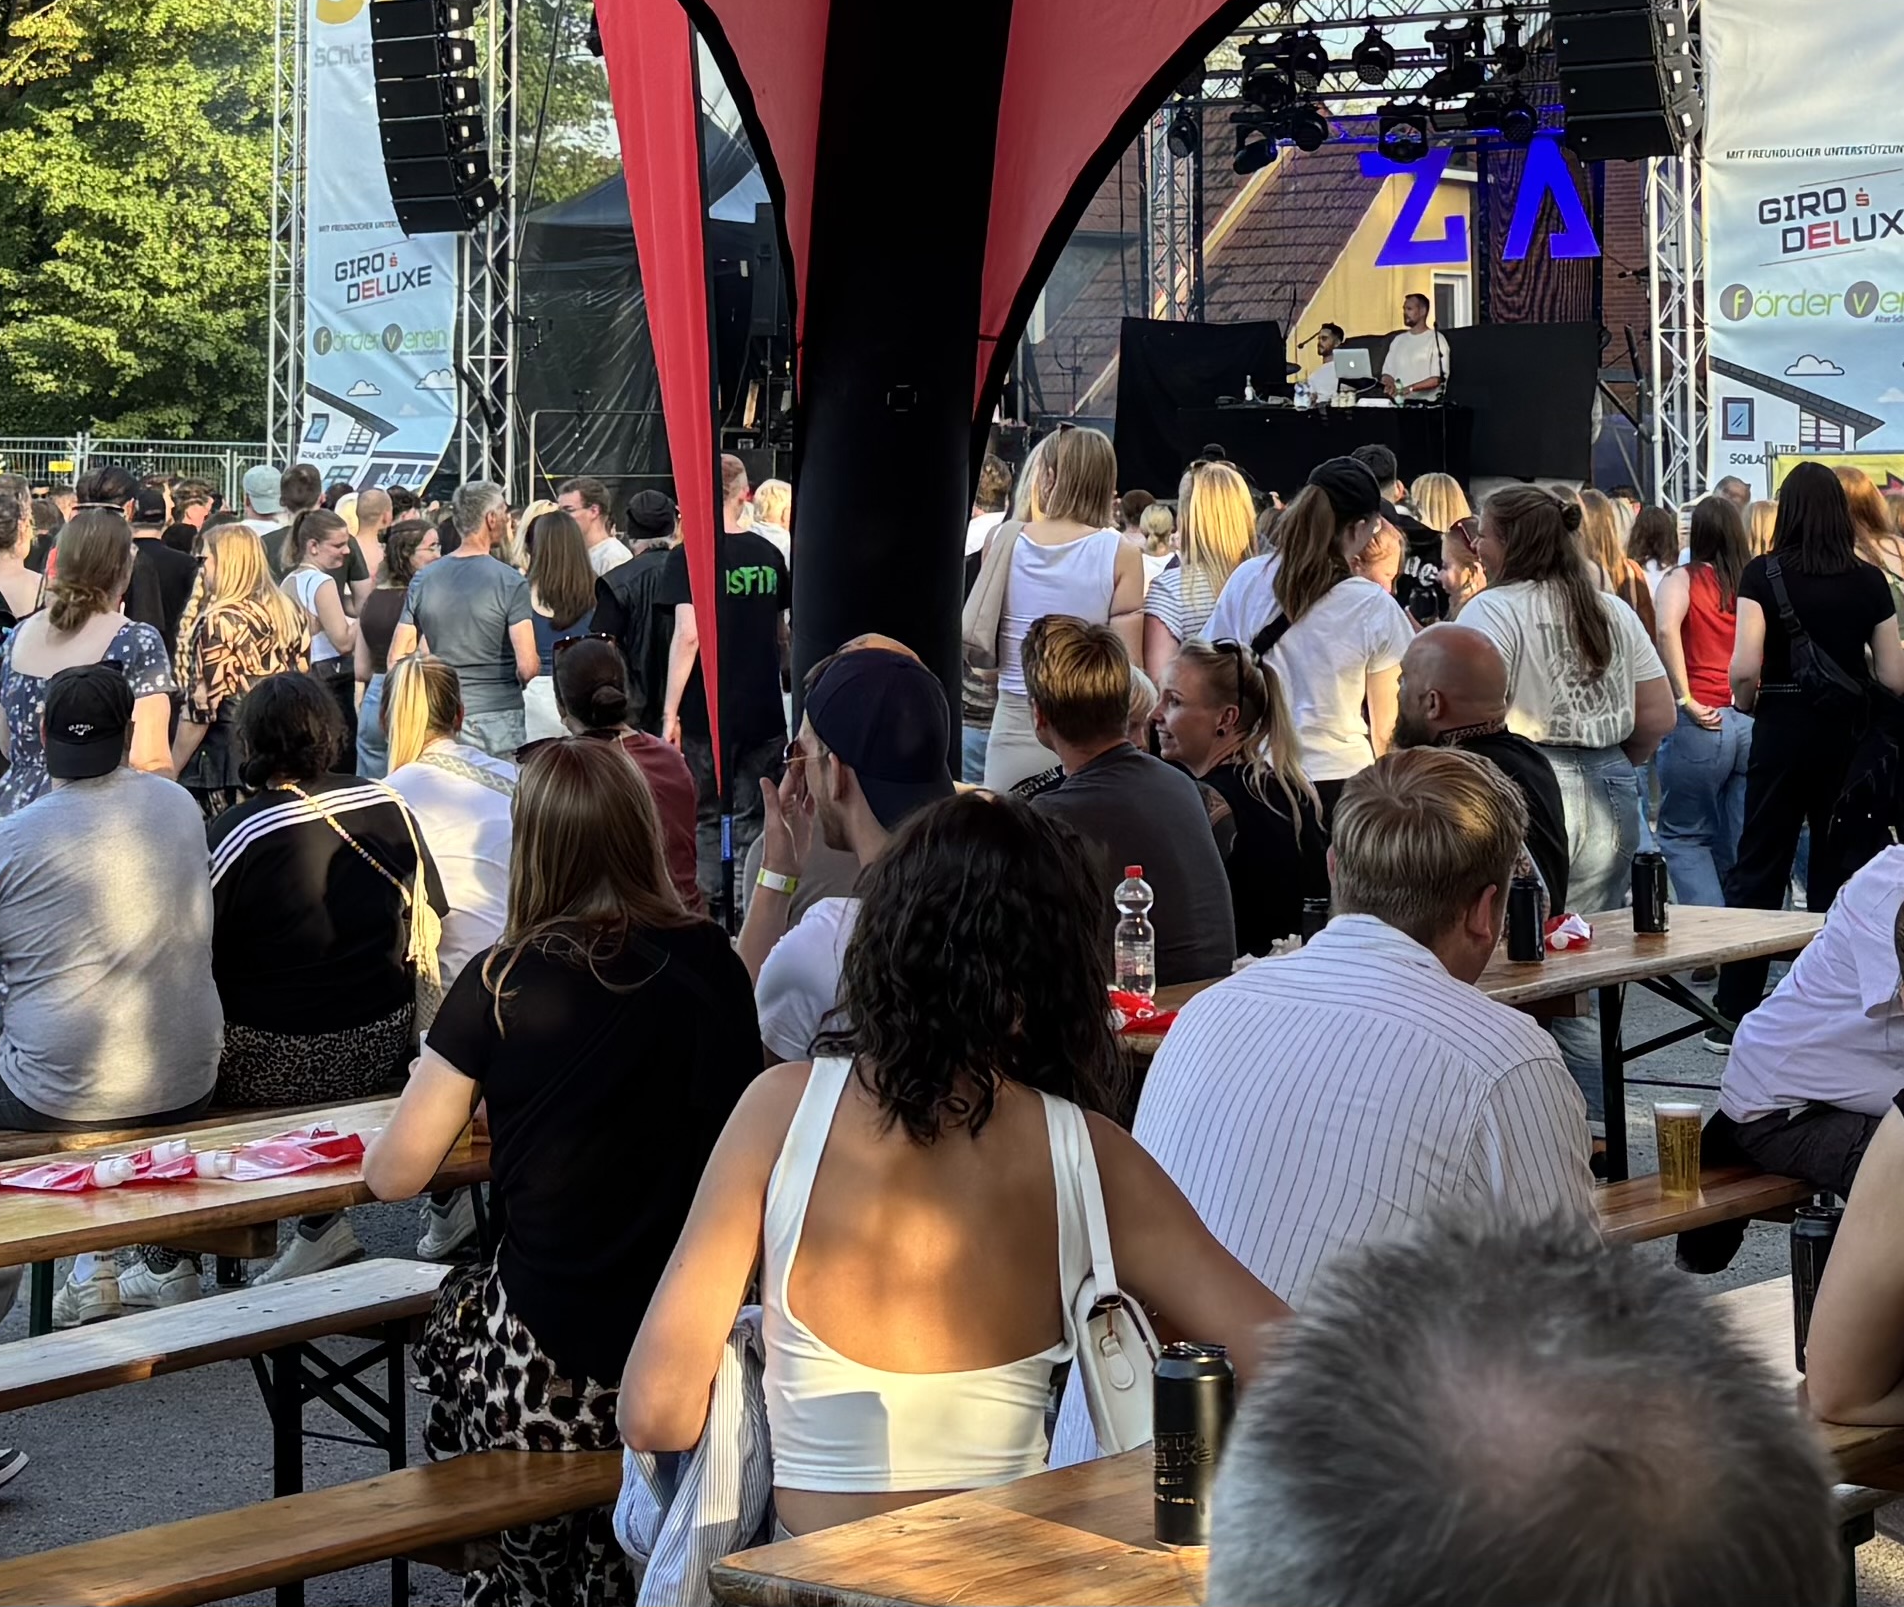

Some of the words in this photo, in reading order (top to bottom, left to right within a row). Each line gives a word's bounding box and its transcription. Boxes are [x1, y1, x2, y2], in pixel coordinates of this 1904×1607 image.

[1747, 146, 1821, 159] FREUNDLICHER
[1758, 186, 1847, 225] GIRO
[335, 252, 385, 282] GIRO
[346, 265, 433, 304] DELUXE
